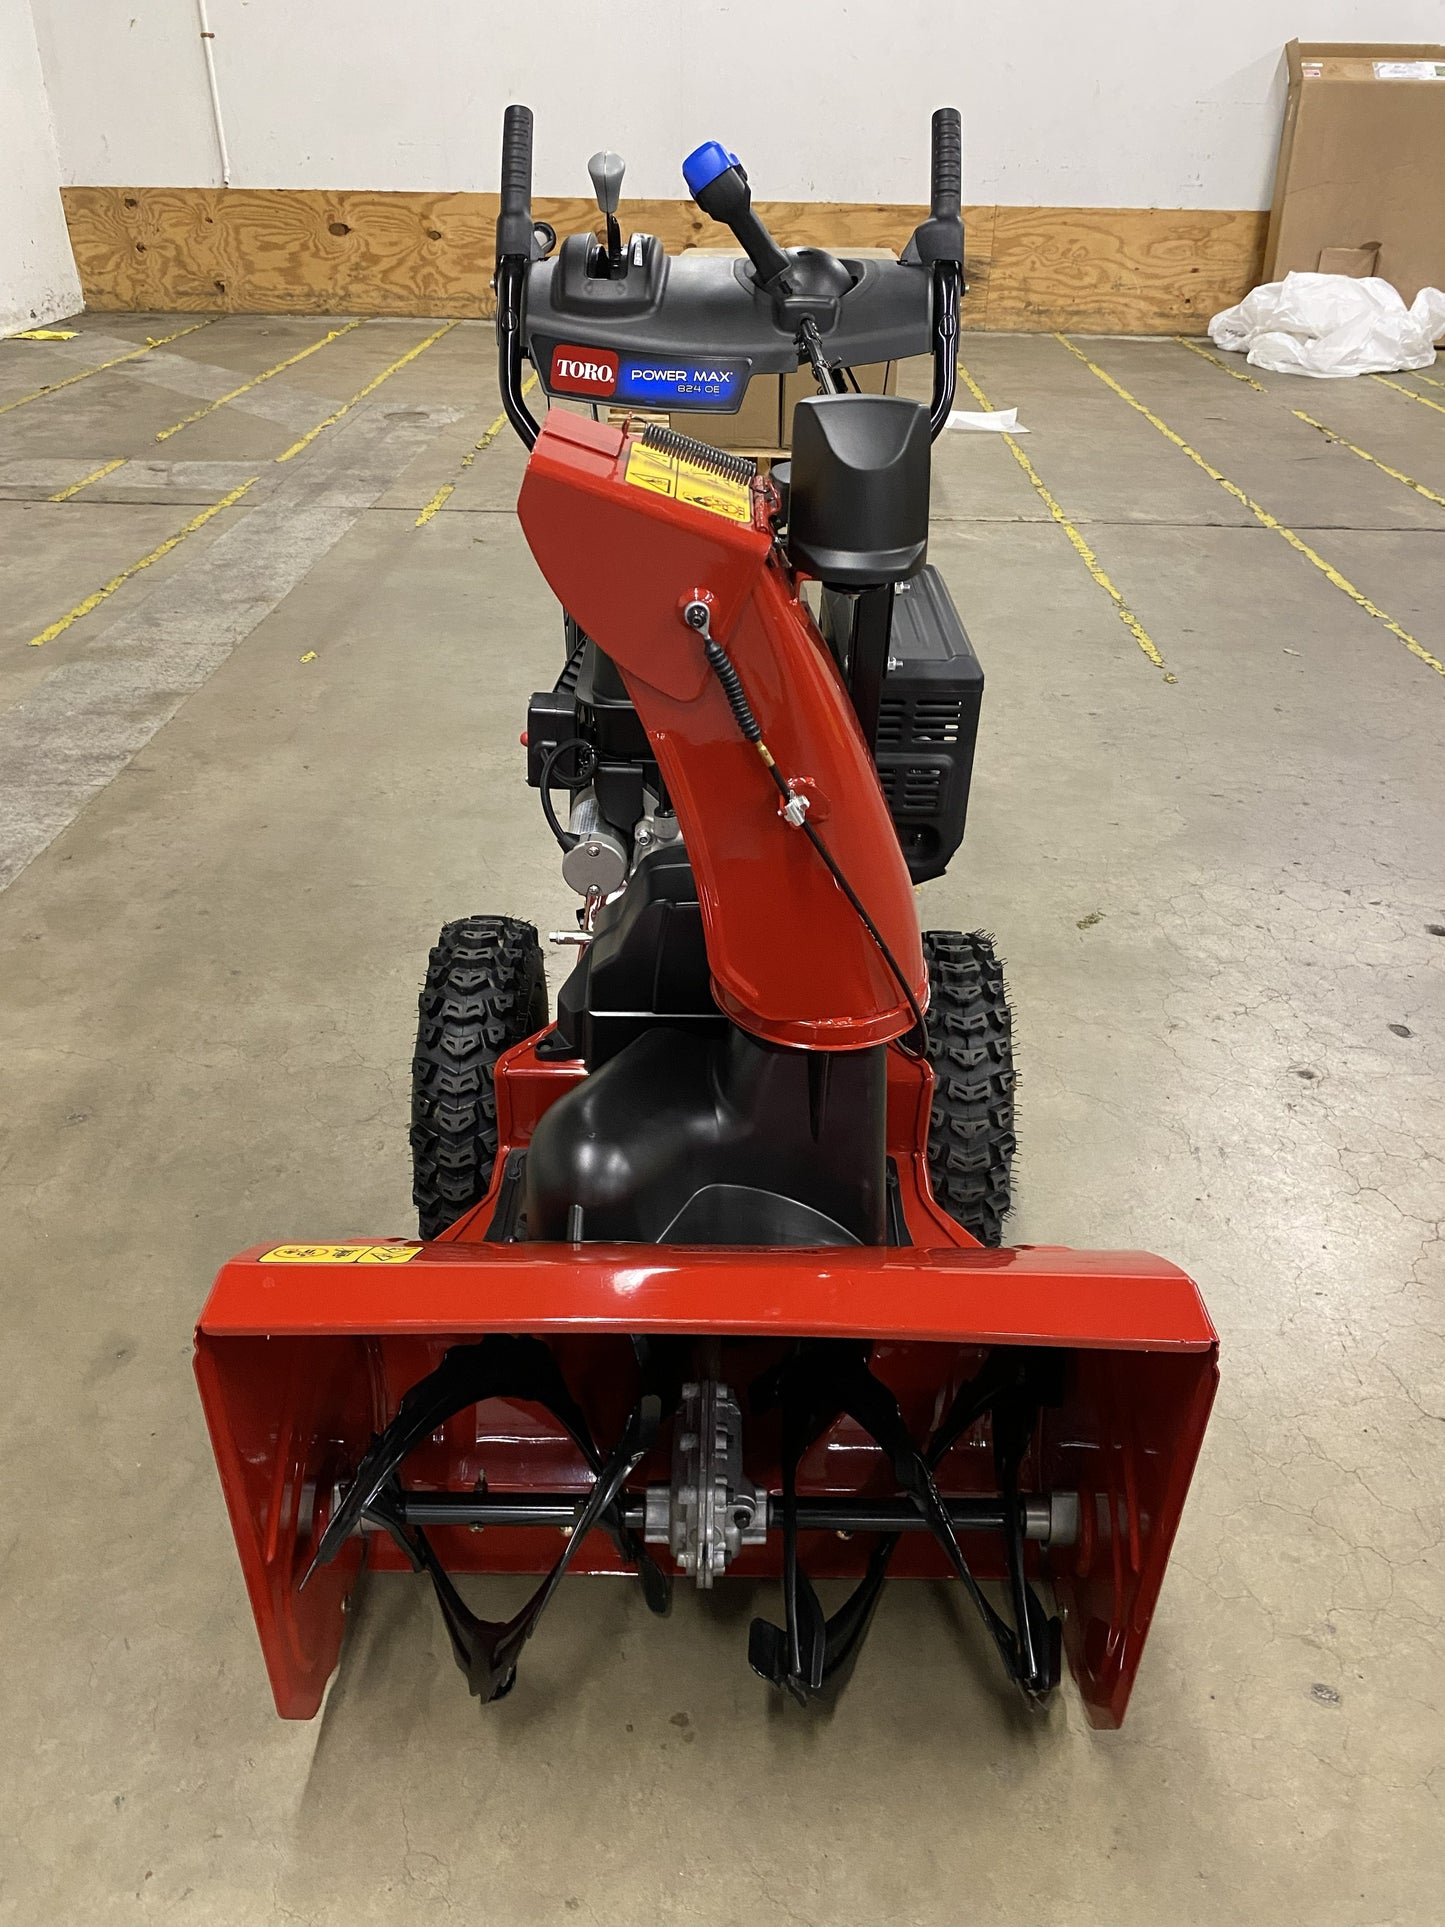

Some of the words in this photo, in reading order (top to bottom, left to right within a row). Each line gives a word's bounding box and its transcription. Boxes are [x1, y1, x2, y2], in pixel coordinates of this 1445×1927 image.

[557, 359, 613, 383] TORO
[631, 370, 687, 382] POWER
[693, 371, 730, 383] MAX
[677, 384, 702, 393] 824
[704, 385, 720, 394] OE
